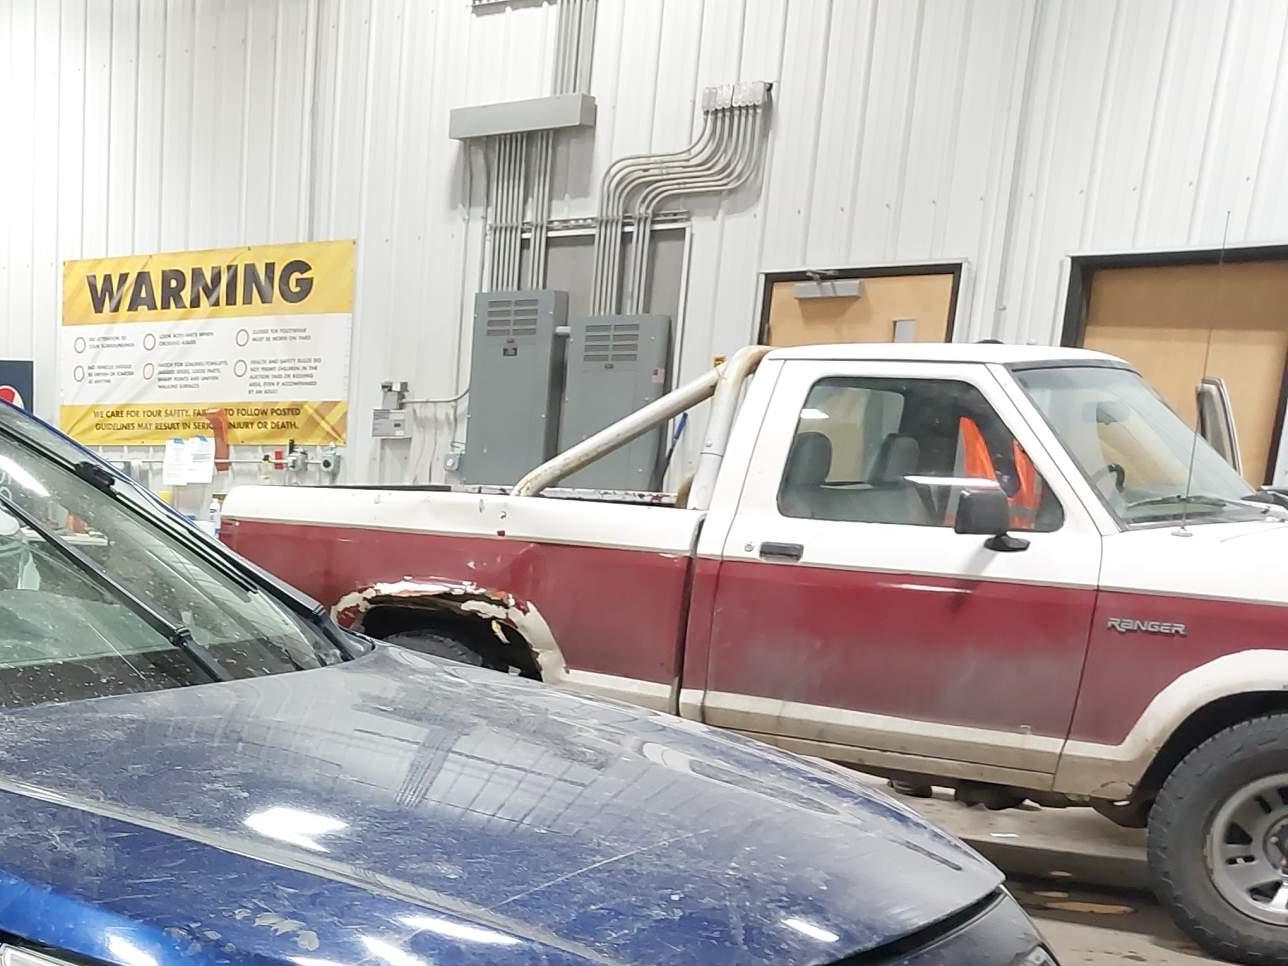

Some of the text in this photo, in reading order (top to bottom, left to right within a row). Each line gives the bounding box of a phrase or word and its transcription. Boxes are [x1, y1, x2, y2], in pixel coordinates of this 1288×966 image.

[86, 260, 314, 314] WARNING
[106, 409, 125, 419] CARE
[127, 409, 141, 418] FOR
[143, 408, 162, 418] YOUR
[224, 407, 301, 417] TO FOLLOW POSTED
[95, 422, 136, 431] GUIDELINES
[137, 422, 153, 431] MAY
[155, 422, 180, 431] RESULT
[182, 422, 191, 431] IN
[256, 421, 269, 430] OR
[1107, 617, 1187, 635] RANGER
